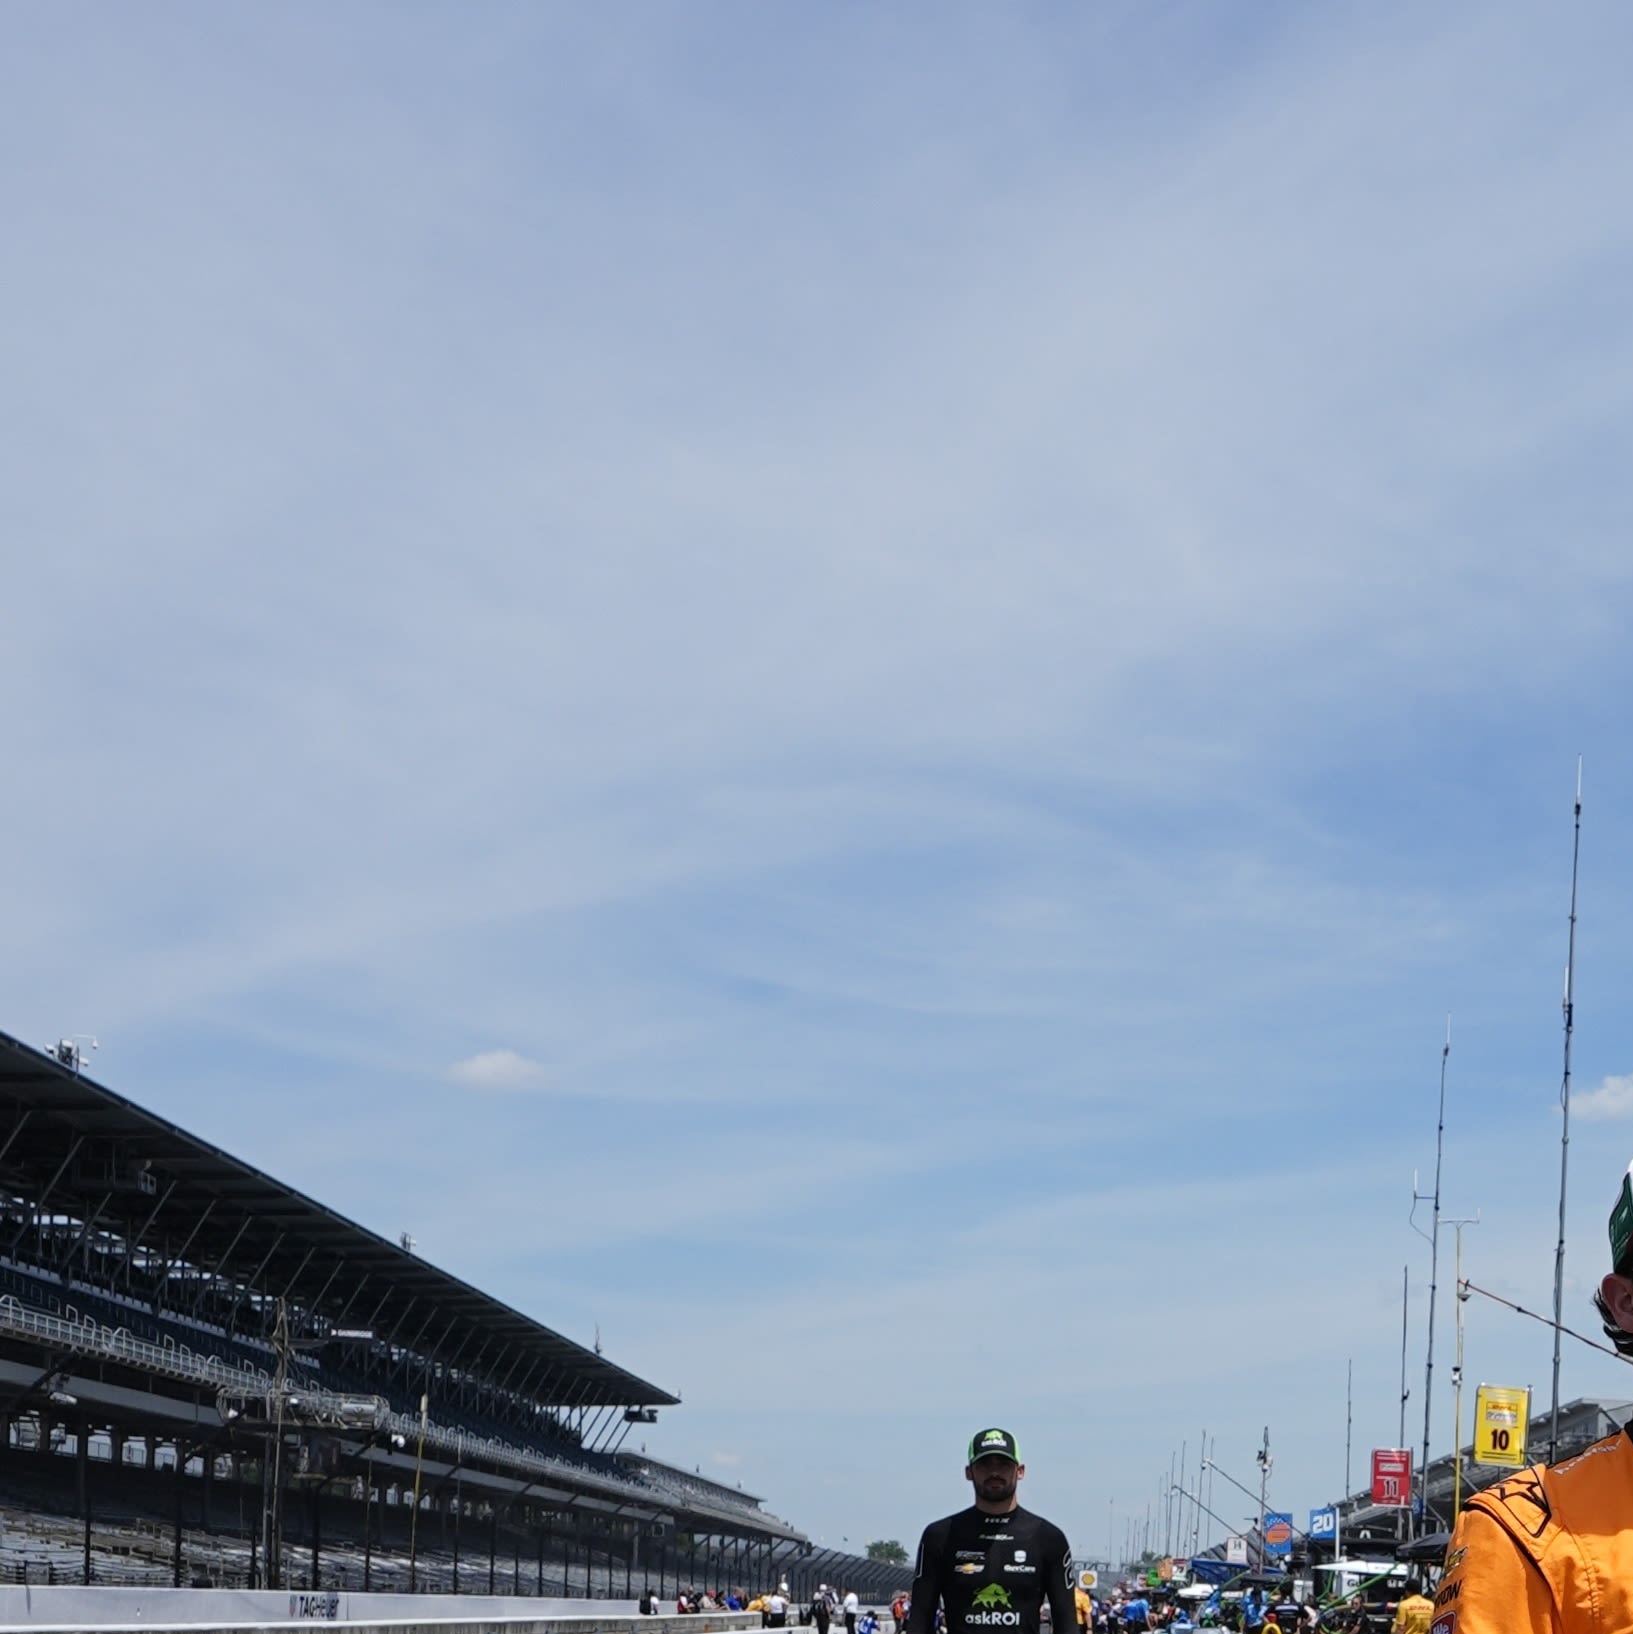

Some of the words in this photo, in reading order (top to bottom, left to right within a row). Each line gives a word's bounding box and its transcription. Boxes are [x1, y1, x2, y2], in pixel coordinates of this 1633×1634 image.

[1491, 1428, 1510, 1451] 10
[1312, 1513, 1334, 1534] 20
[965, 1611, 1020, 1626] askROI
